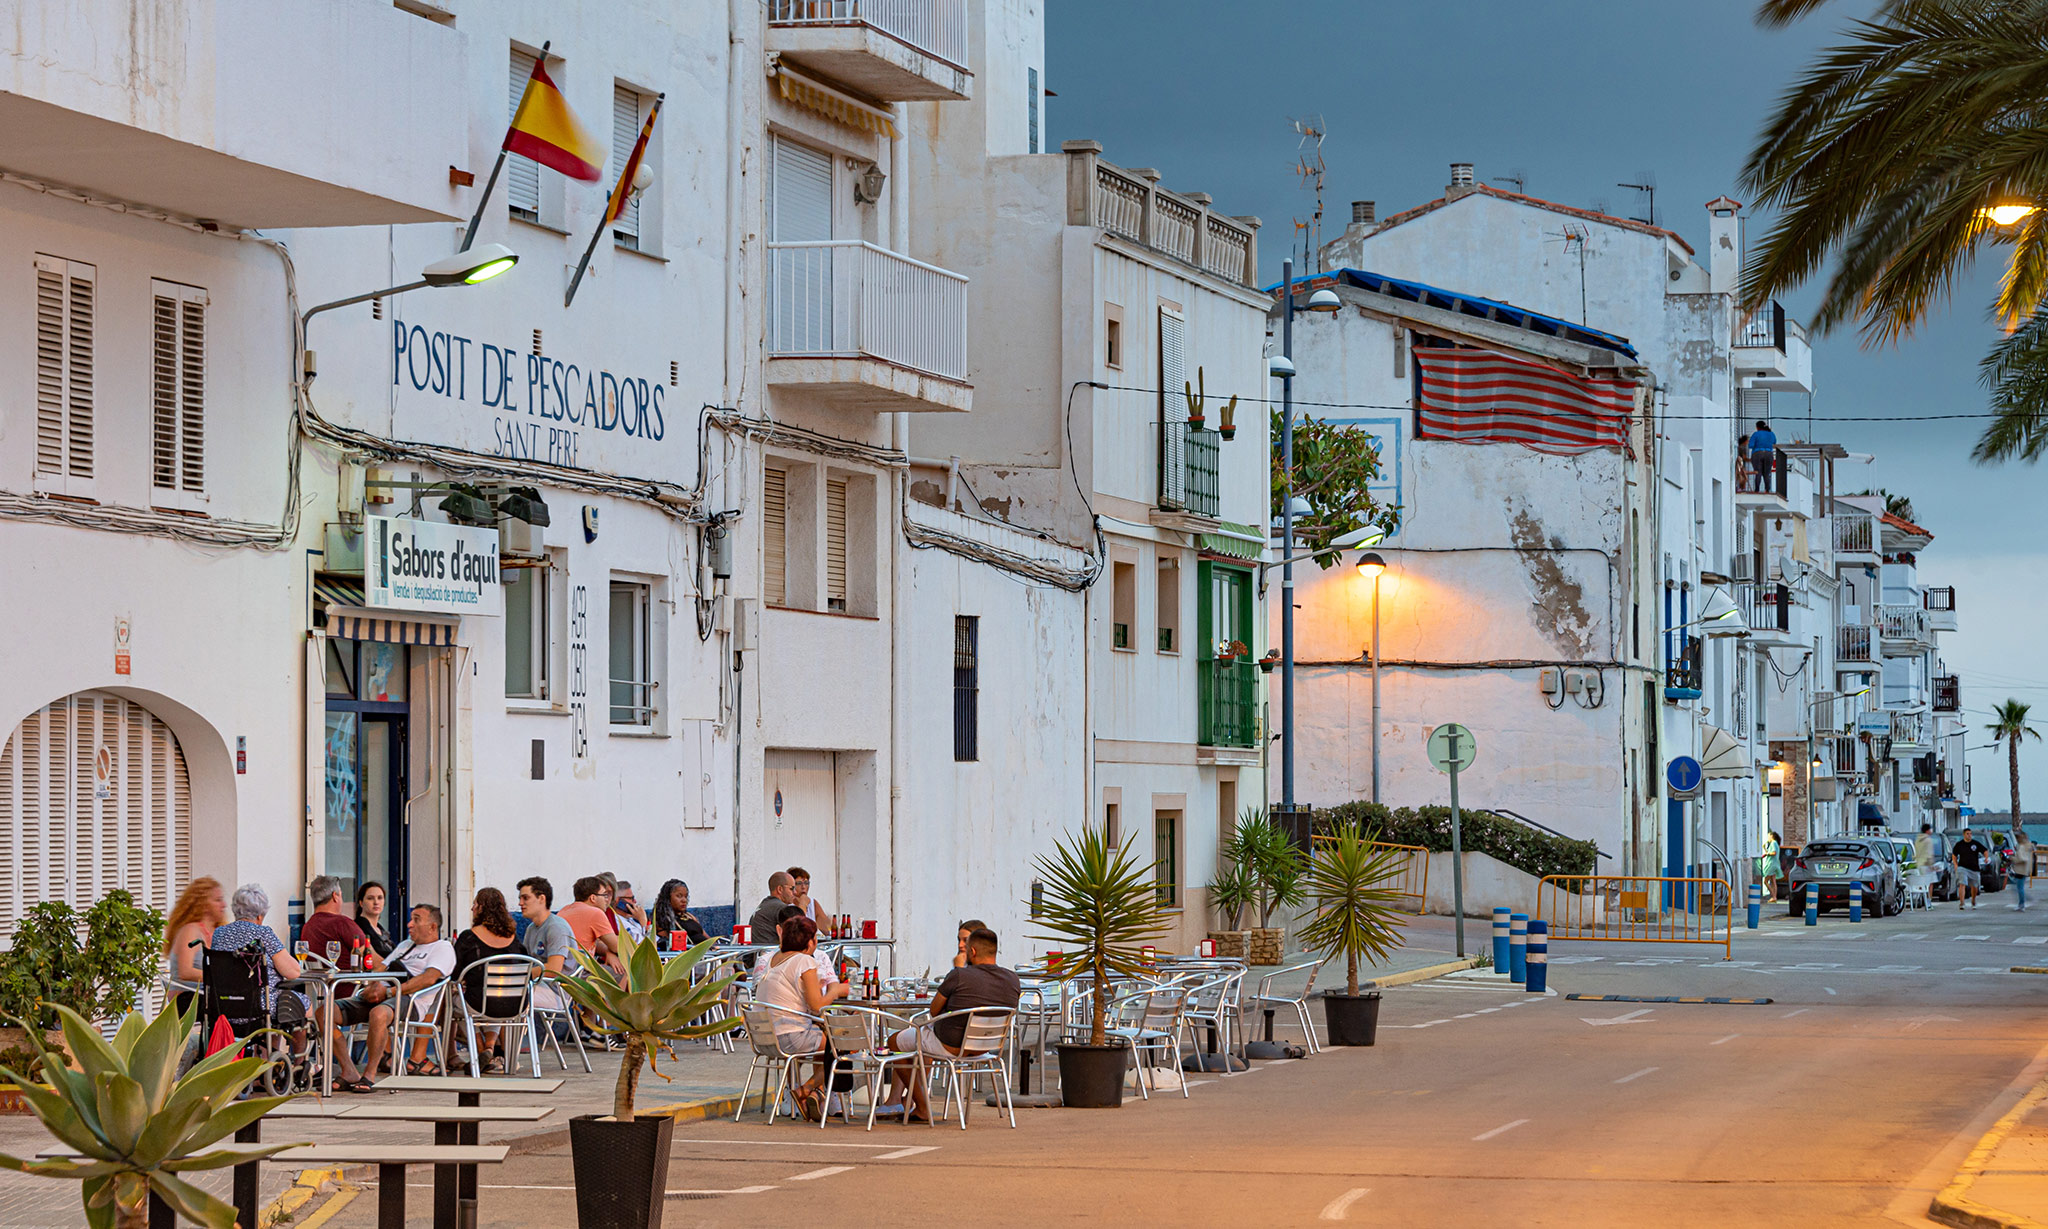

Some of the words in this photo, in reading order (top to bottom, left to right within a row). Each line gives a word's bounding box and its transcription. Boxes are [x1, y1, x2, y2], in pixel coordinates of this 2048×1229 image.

[393, 319, 472, 401] POSIT
[481, 343, 517, 412] DE
[527, 353, 665, 441] PESCADORS
[494, 417, 541, 460] SANT
[548, 427, 579, 468] PERE
[392, 532, 445, 580] Sabors
[451, 539, 497, 596] d'aquí
[392, 580, 410, 599] Venda
[414, 582, 442, 605] degustació
[443, 584, 451, 601] de
[451, 586, 478, 606] productes
